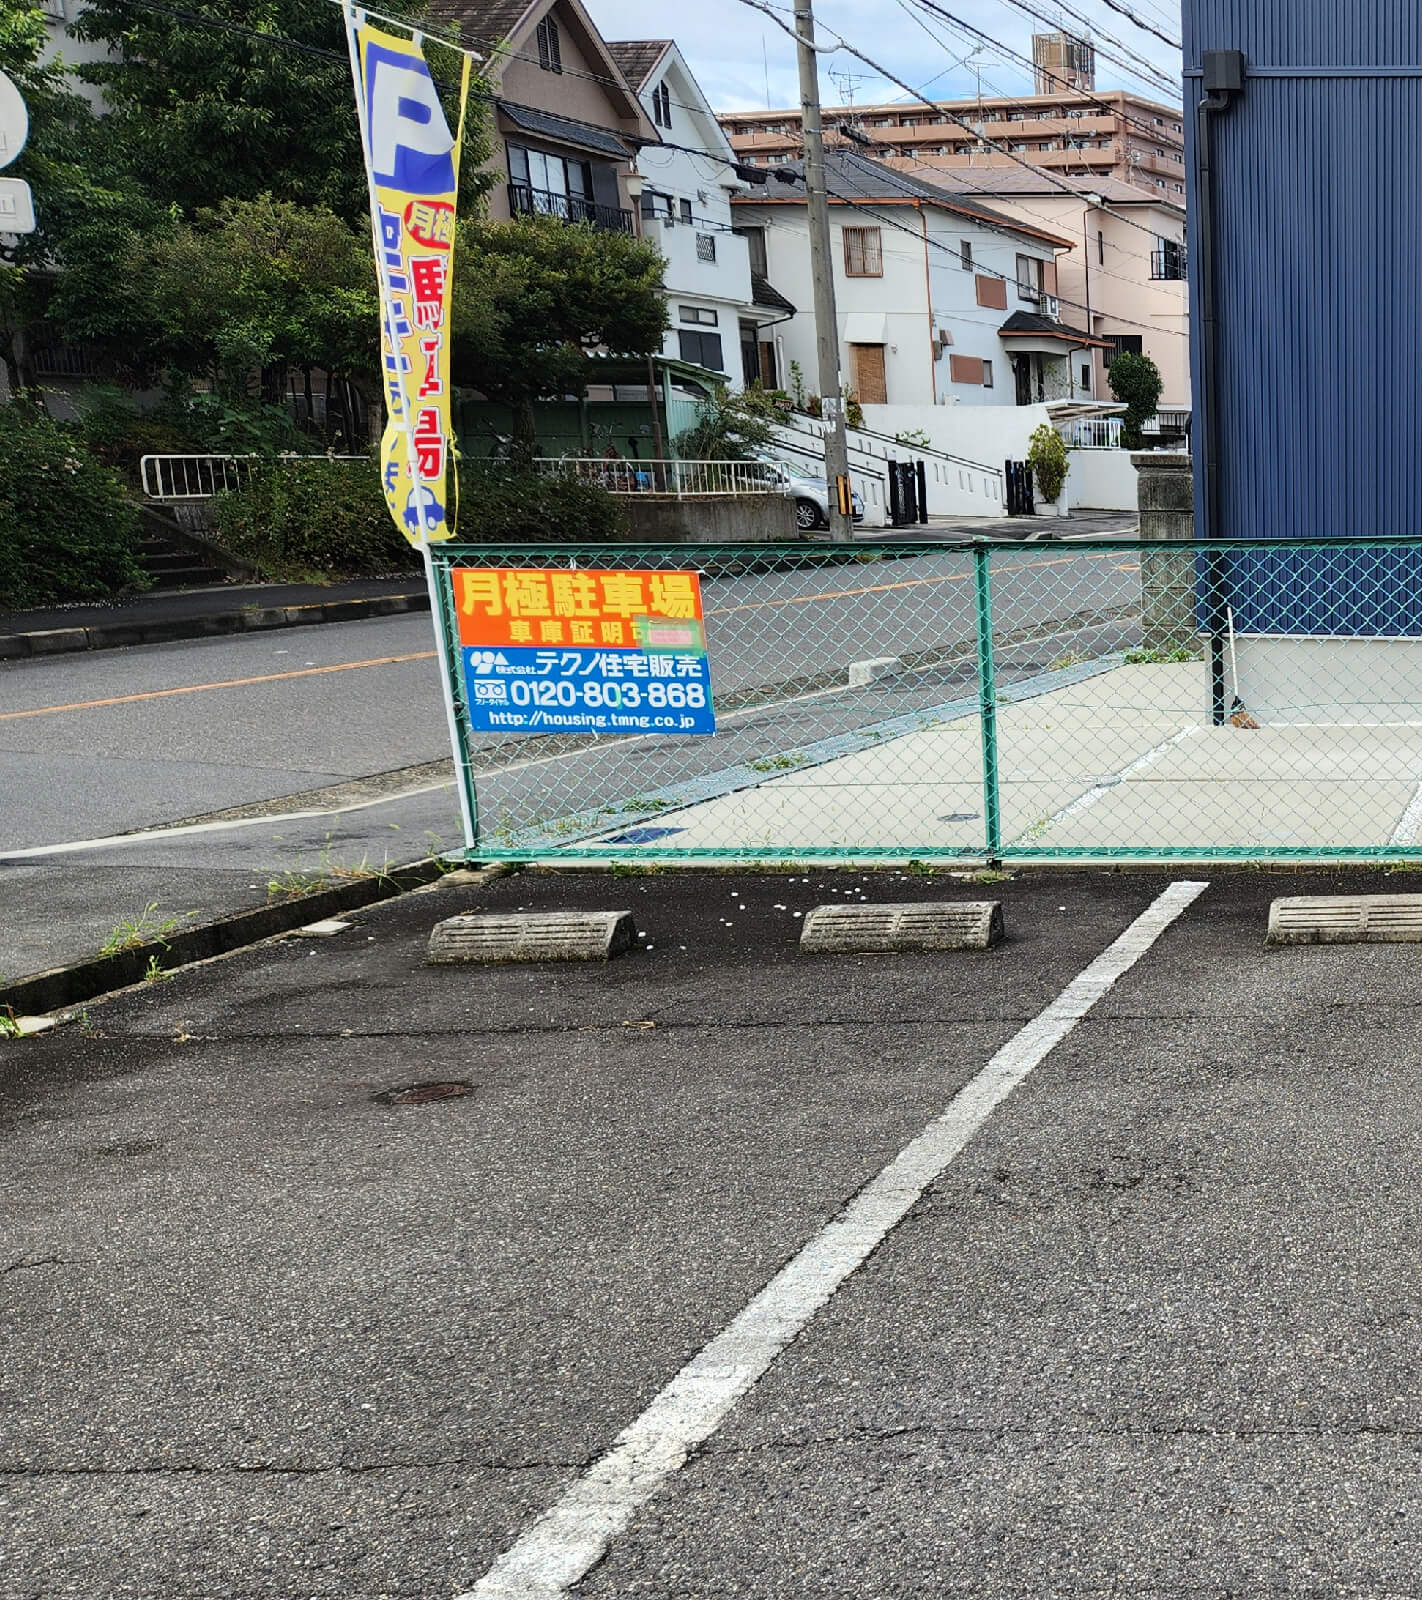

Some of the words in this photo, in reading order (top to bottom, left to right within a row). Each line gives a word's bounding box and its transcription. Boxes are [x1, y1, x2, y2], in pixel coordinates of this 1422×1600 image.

[372, 60, 456, 176] P
[462, 572, 696, 618] 月極駐車場
[510, 680, 705, 708] 0120-803-868
[489, 711, 695, 729] http://housing.tmng.co.jp
